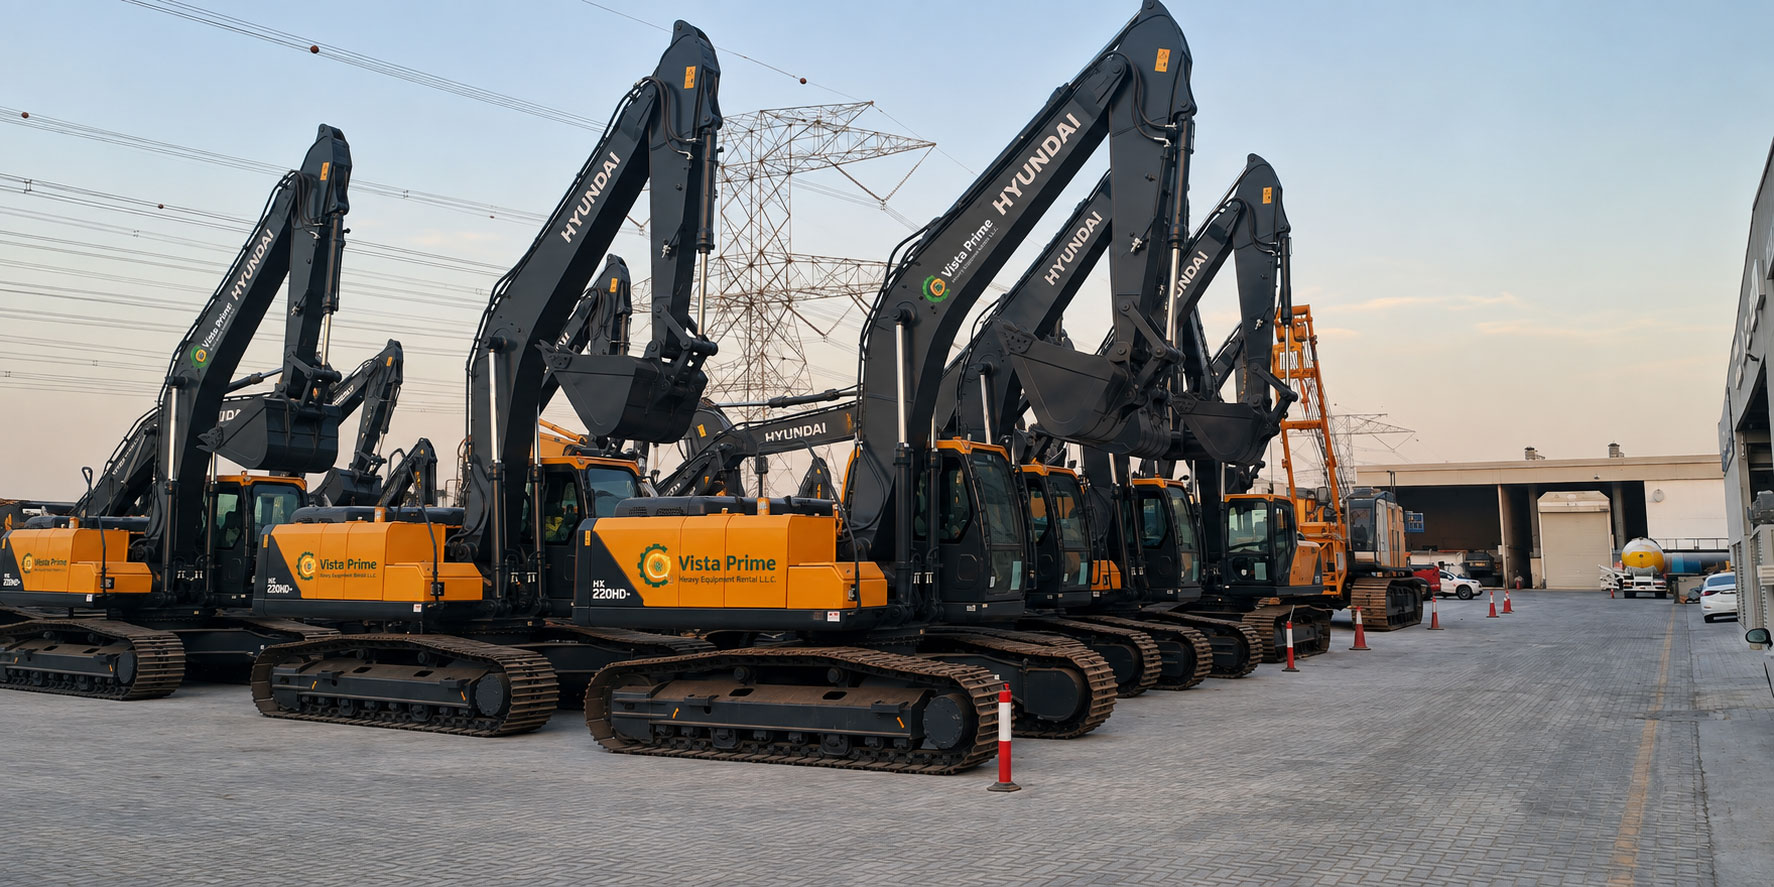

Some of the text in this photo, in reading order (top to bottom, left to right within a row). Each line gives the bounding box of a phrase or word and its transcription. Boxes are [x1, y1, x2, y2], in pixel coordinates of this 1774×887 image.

[992, 112, 1081, 216] HYUNDAI
[560, 151, 621, 243] HYUNDAI
[231, 228, 274, 301] HYUNDAI
[941, 250, 968, 278] Vista
[964, 218, 994, 252] Prime
[1044, 210, 1103, 286] HYUNDAI
[1177, 250, 1209, 298] UNDAI
[765, 422, 827, 442] HYUNDAI
[319, 558, 377, 570] Vista Prime
[592, 580, 606, 588] HX
[678, 554, 777, 571] Vista Prime
